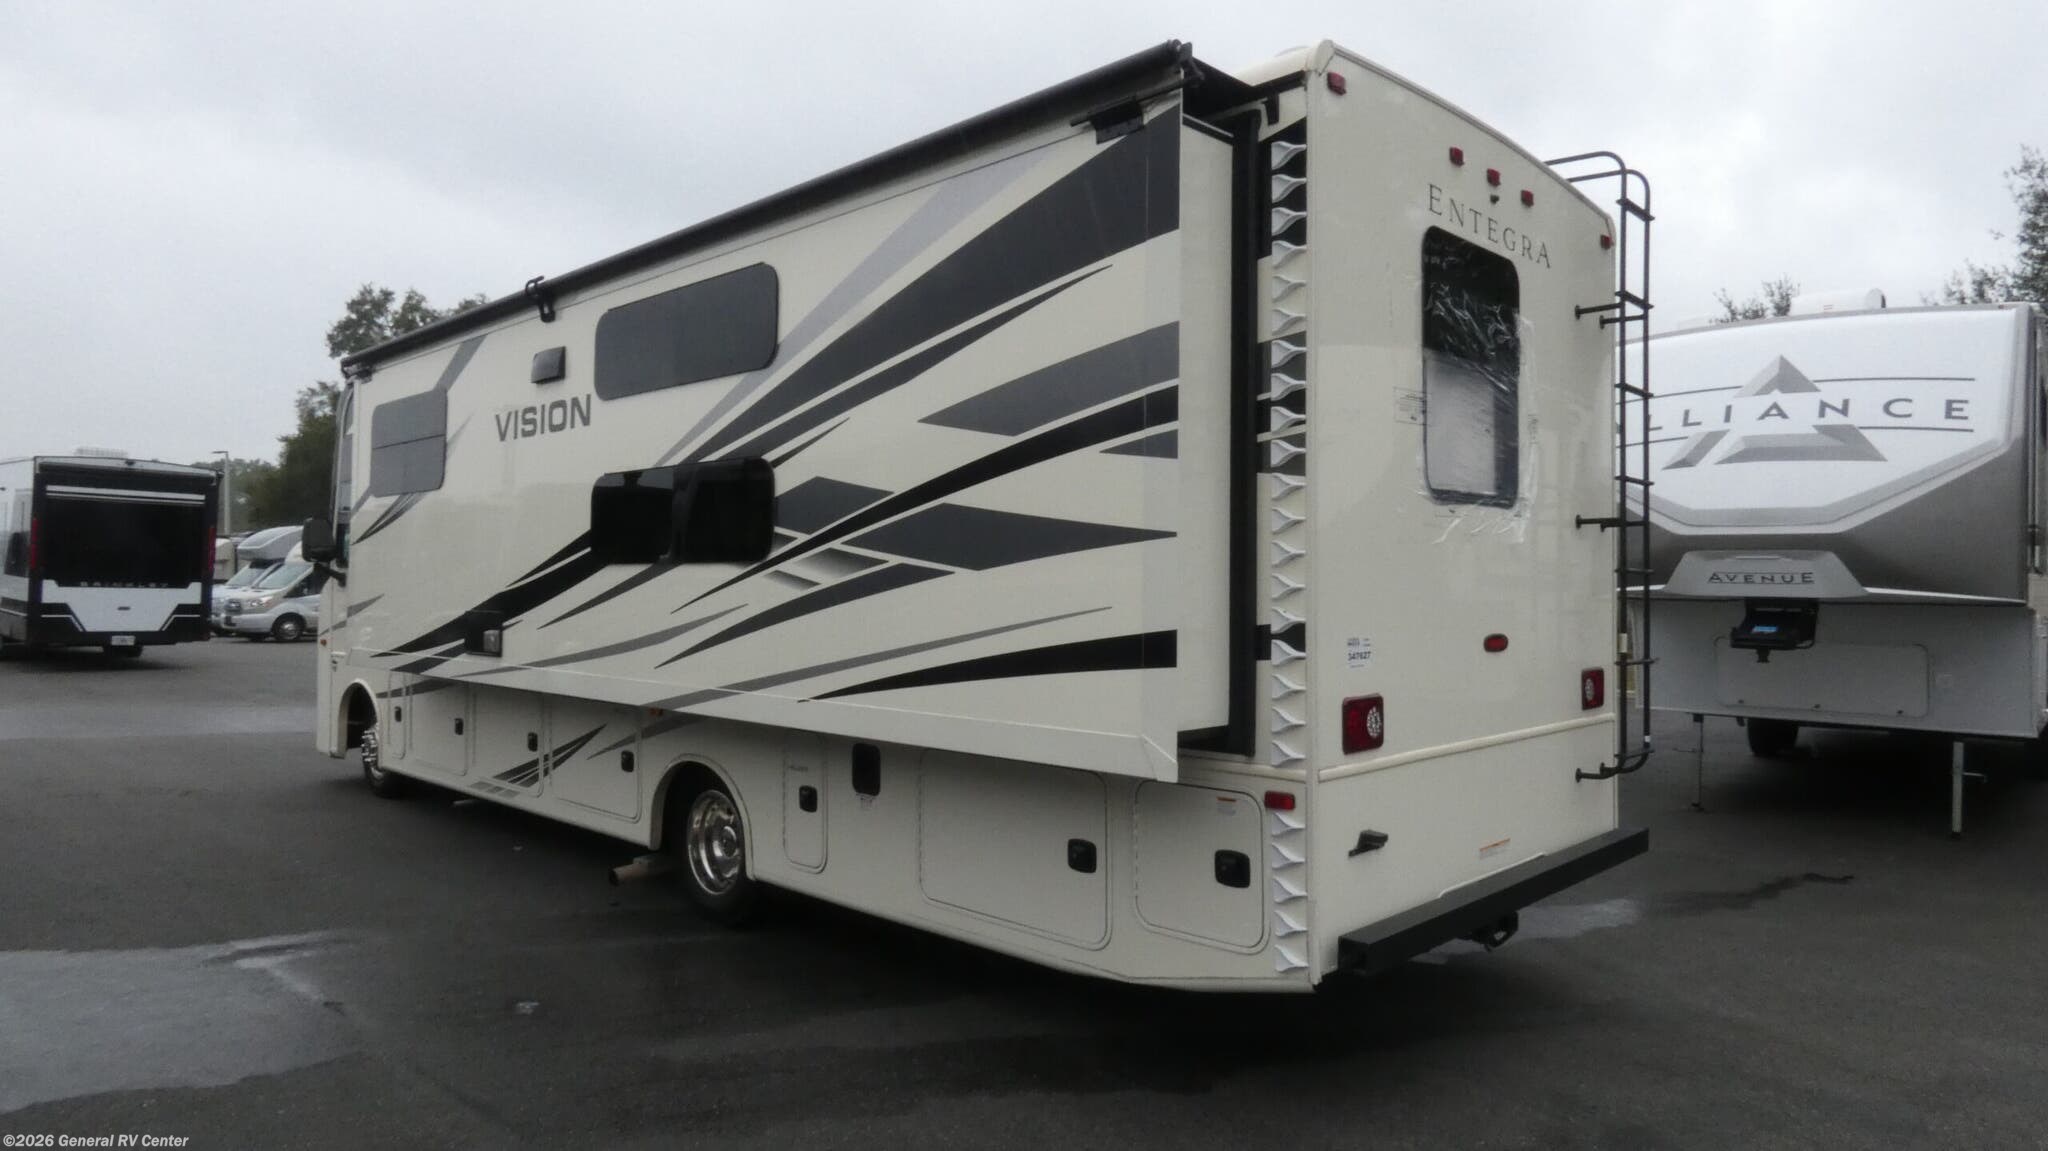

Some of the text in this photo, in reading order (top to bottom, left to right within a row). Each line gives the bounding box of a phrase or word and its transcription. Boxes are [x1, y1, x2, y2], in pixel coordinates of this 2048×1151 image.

[1429, 184, 1551, 269] ENTEGRA
[495, 393, 591, 442] VISION
[1616, 398, 1969, 434] LLIANCE
[1707, 571, 1815, 584] AVENUE
